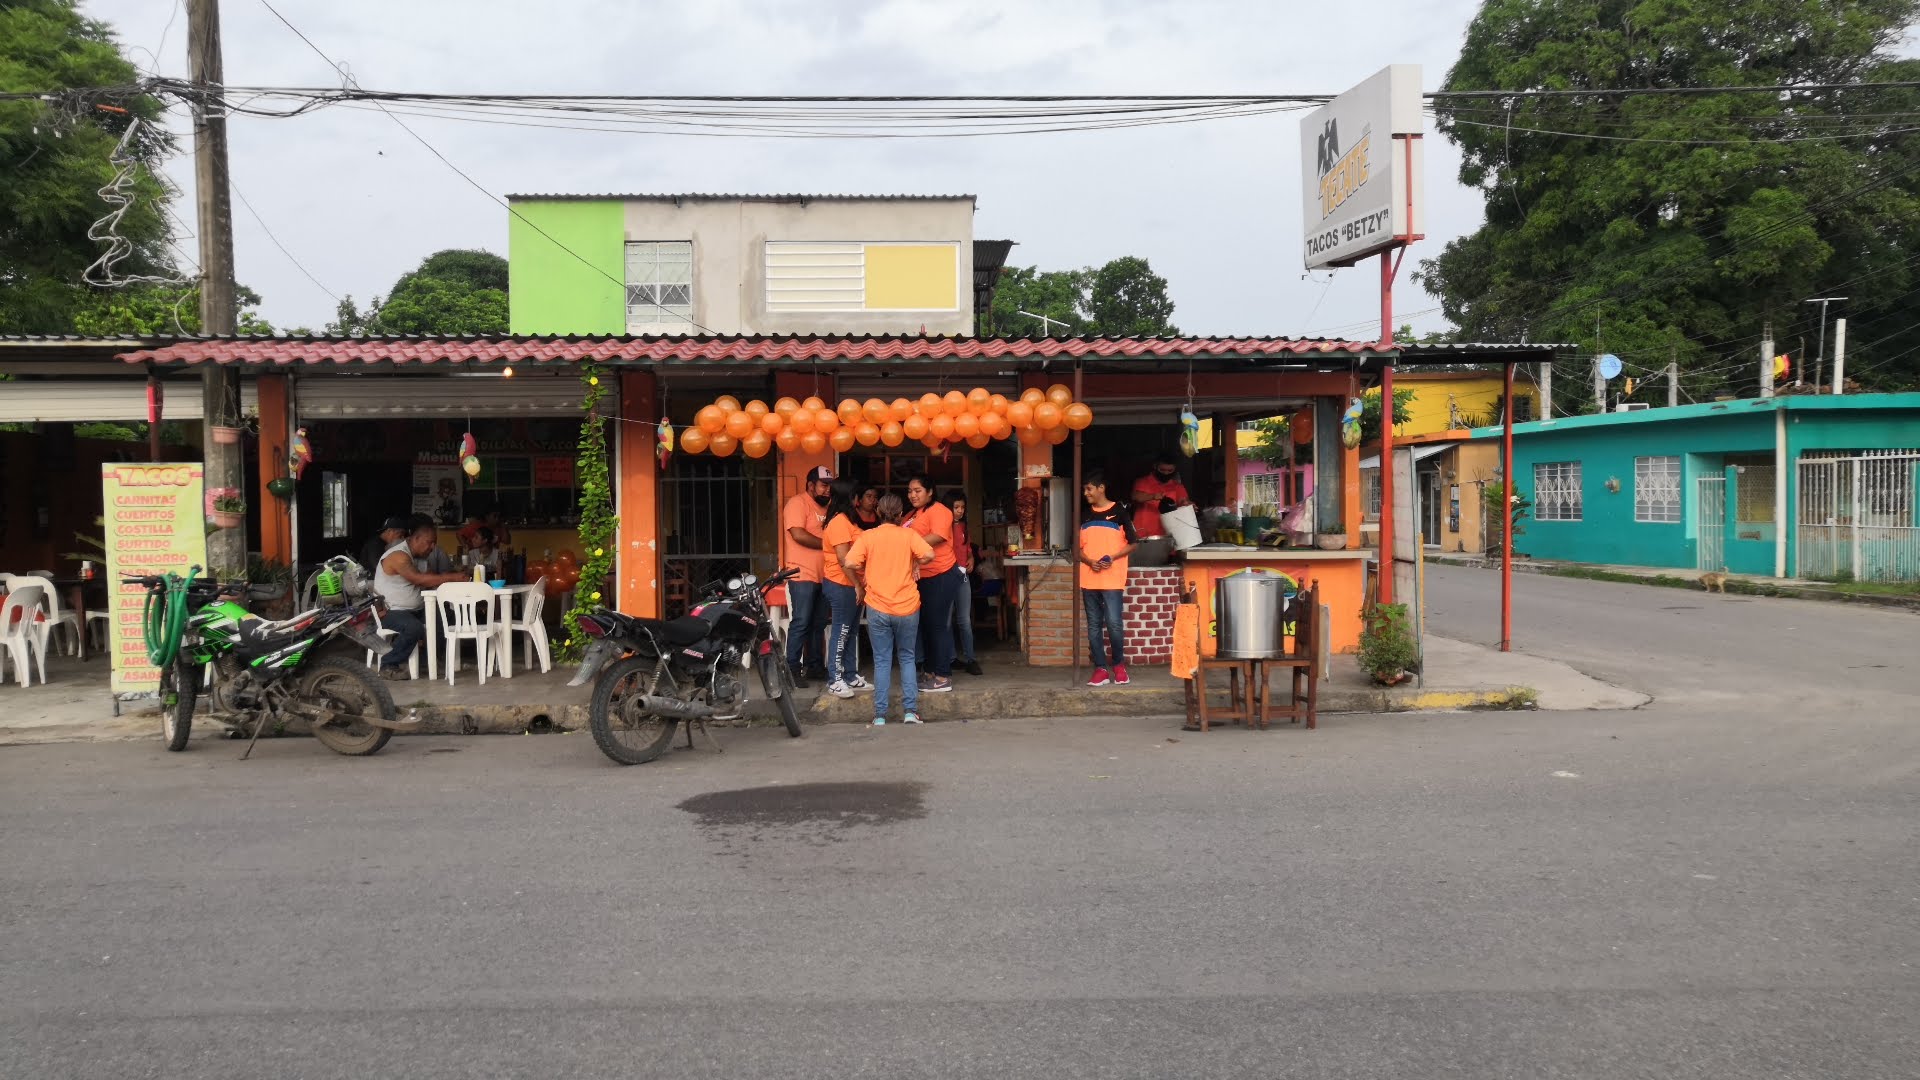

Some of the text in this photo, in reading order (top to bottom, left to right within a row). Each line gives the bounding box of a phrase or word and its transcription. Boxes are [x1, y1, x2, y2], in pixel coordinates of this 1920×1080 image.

[1318, 133, 1371, 220] TECATE
[1307, 228, 1339, 257] TACOS
[115, 467, 193, 487] TACOS
[116, 495, 177, 505] CARNITAS
[116, 509, 176, 520] CUERITOS
[117, 524, 174, 534] COSTILLA
[117, 539, 171, 549] SURTIDO
[118, 553, 188, 563] CHAMORRO
